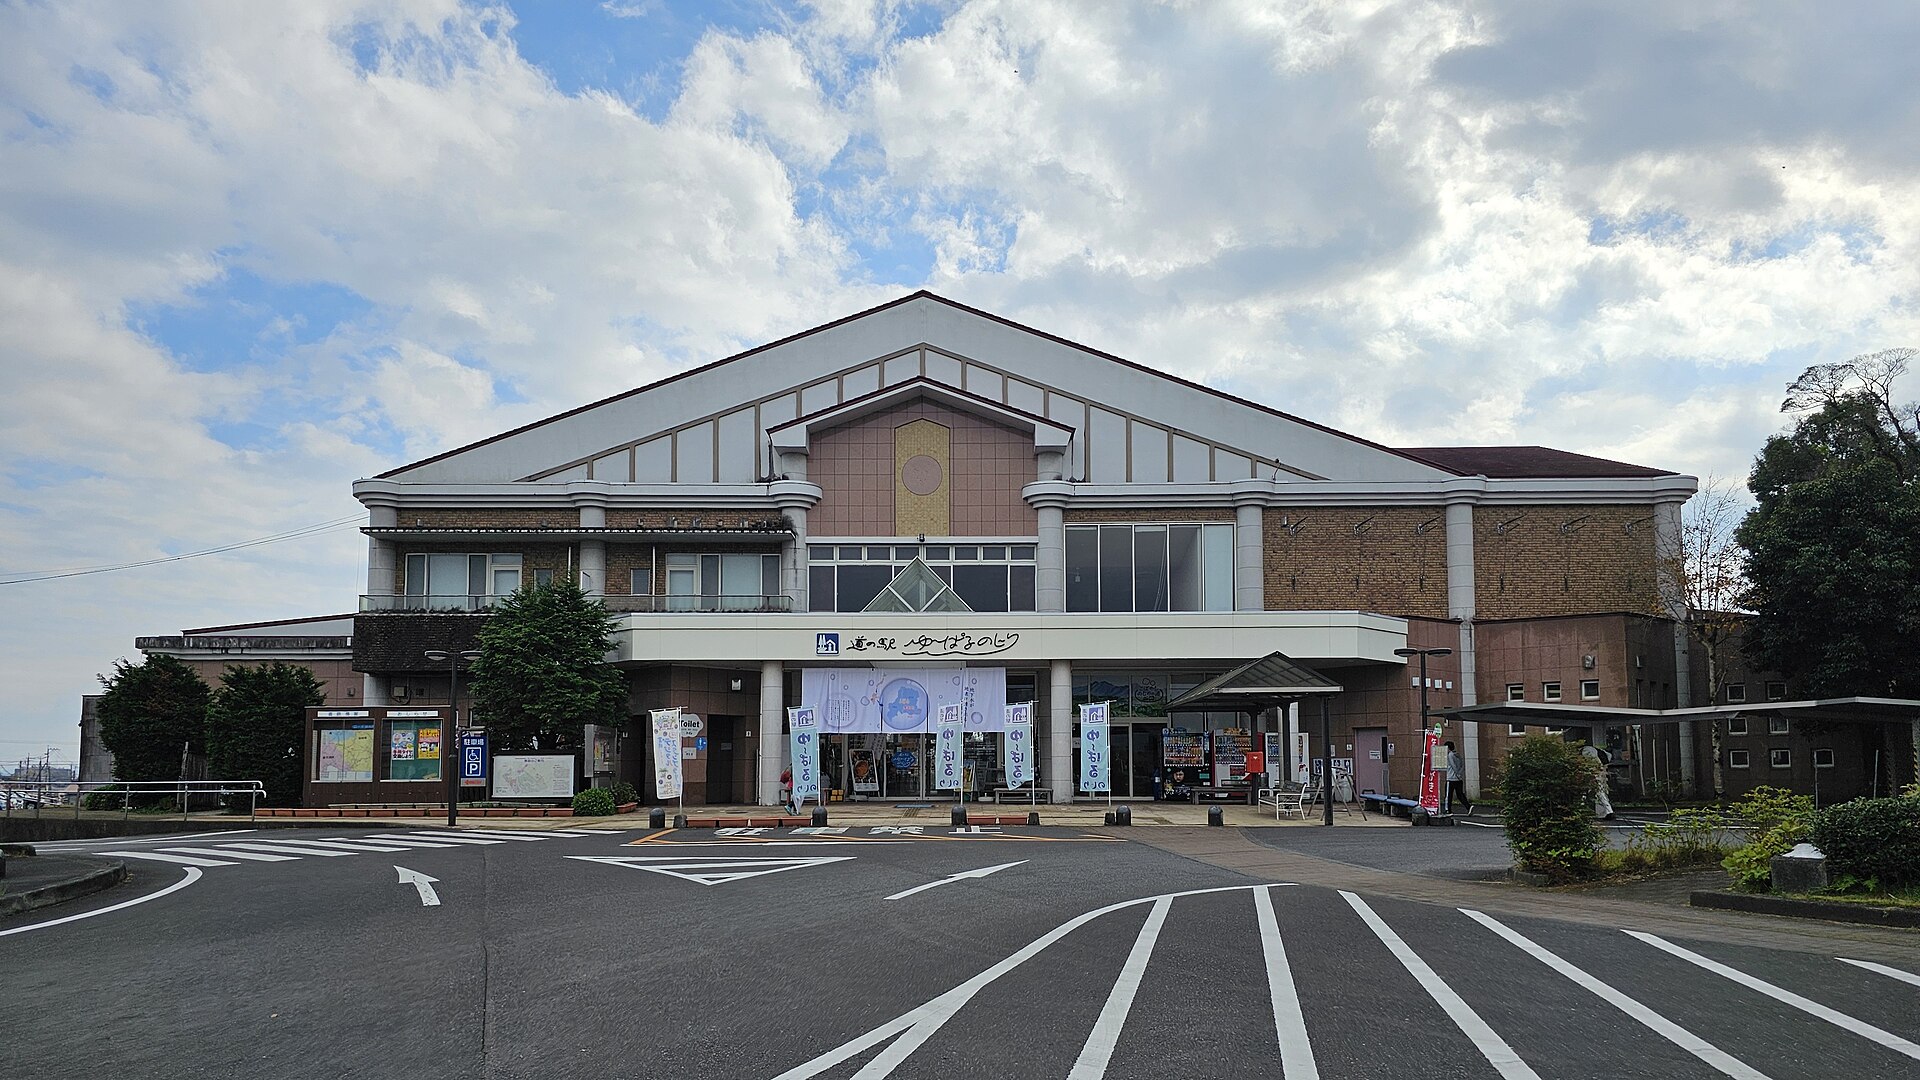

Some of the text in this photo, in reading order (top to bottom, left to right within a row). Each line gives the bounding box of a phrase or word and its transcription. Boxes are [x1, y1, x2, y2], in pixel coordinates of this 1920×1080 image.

[846, 635, 897, 652] 道の駅
[679, 720, 700, 728] Toilet
[463, 738, 484, 746] 駐車場
[469, 763, 478, 774] P
[714, 825, 1004, 837] 駐車禁止
